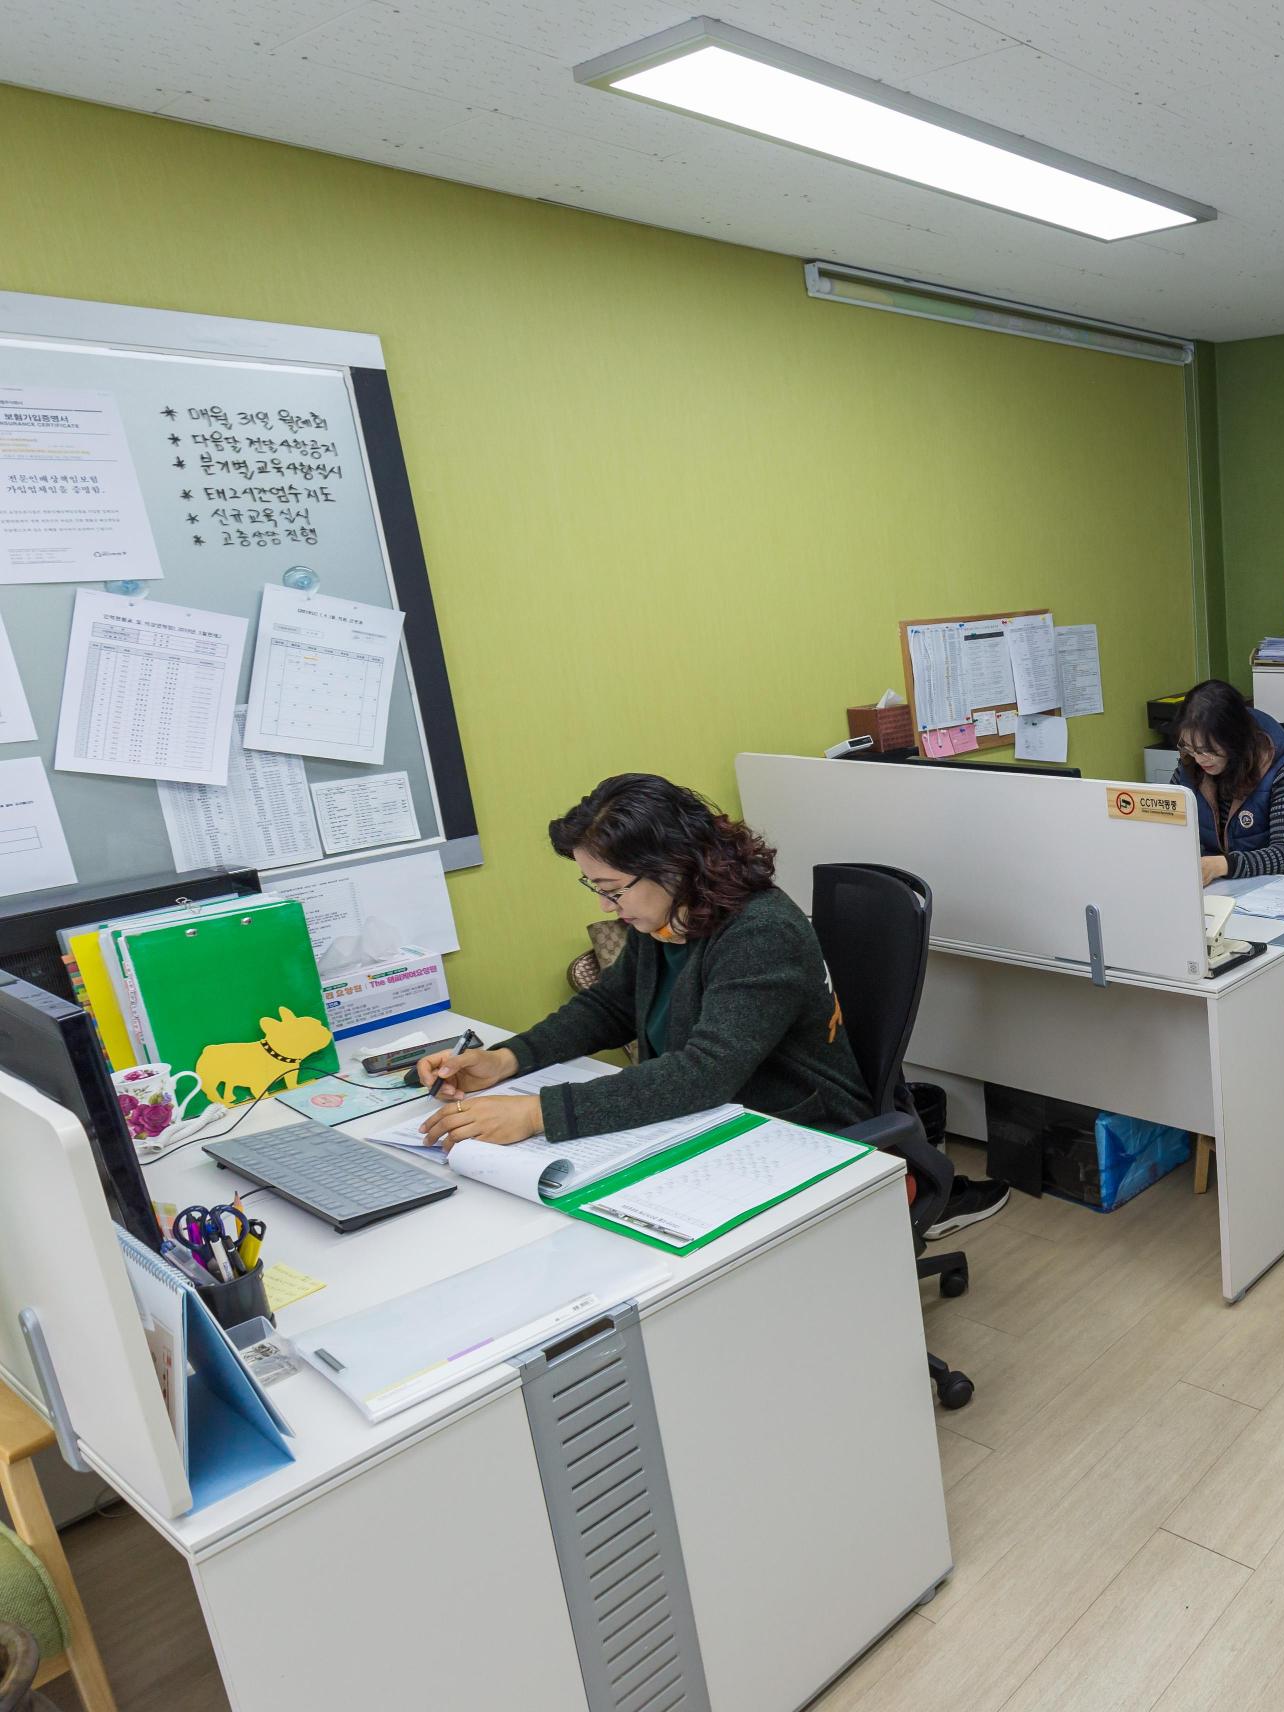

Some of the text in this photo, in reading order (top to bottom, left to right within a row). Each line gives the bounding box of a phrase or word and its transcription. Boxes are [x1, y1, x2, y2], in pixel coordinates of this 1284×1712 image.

[4, 413, 69, 423] 보험가입증명서
[188, 405, 232, 430] 매월
[192, 431, 241, 453] 다음달
[222, 526, 318, 547] 고충상담 진행
[1139, 797, 1177, 811] CCTV작동중
